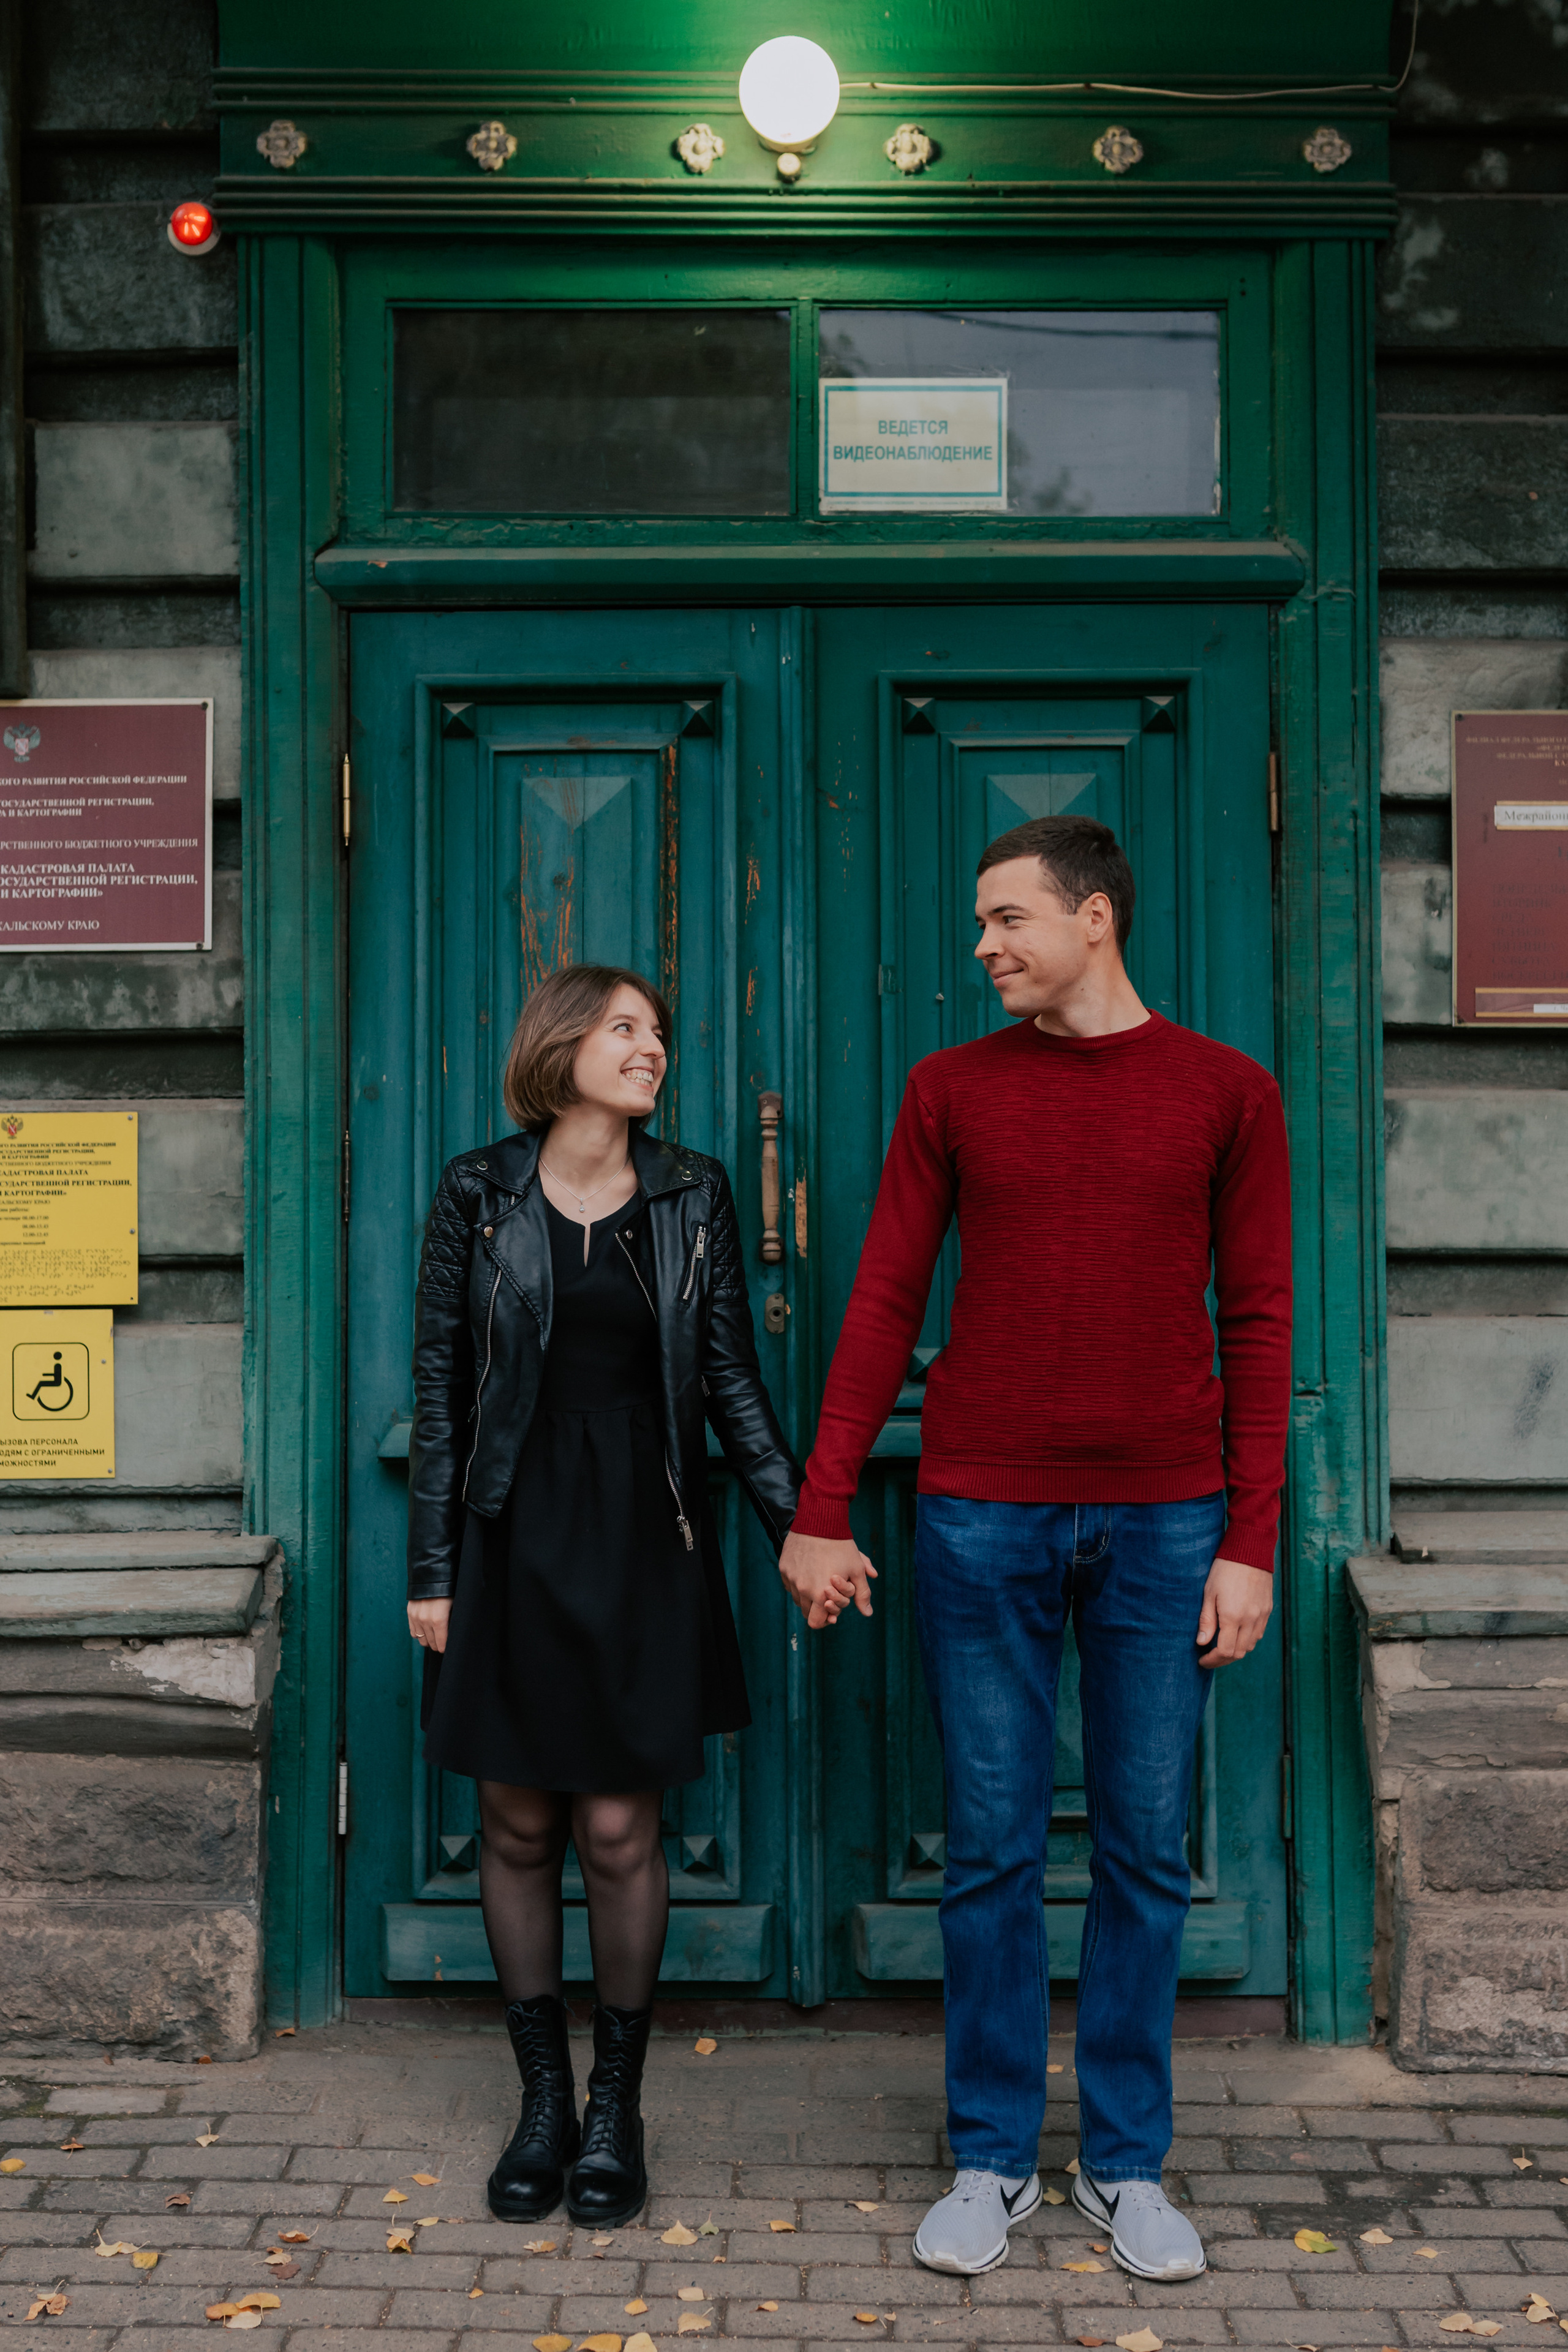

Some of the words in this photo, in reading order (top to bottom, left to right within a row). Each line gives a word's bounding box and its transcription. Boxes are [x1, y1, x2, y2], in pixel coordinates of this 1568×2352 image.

[878, 420, 948, 437] ВЕДЕТСЯ
[833, 446, 992, 462] ВИДЕОНАБЛЮДЕНИЕ
[22, 777, 67, 785] РАЗВИТИЯ
[69, 775, 131, 785] РОССИЙСКОЙ
[132, 775, 187, 785] ФЕДЕРАЦИИ
[0, 797, 86, 808] ОСУДАРСТВЕННОЙ
[88, 797, 154, 807] РЕГИСТРАЦИИ,
[8, 809, 15, 817] И
[17, 807, 82, 817] КАРТОГРАФИИ
[64, 839, 132, 850] БЮДЖЕТНОГО
[134, 838, 198, 849] УЧРЕЖДЕНИЯ
[1, 864, 85, 875] КАДАСТРОВАЯ
[88, 863, 135, 873] ПАЛАТА
[110, 874, 198, 886] РЕГИСТРАЦИИ,
[1, 888, 9, 899] И
[12, 888, 103, 899] КАРТОГРАФИИ»
[67, 919, 100, 930] КРАЮ
